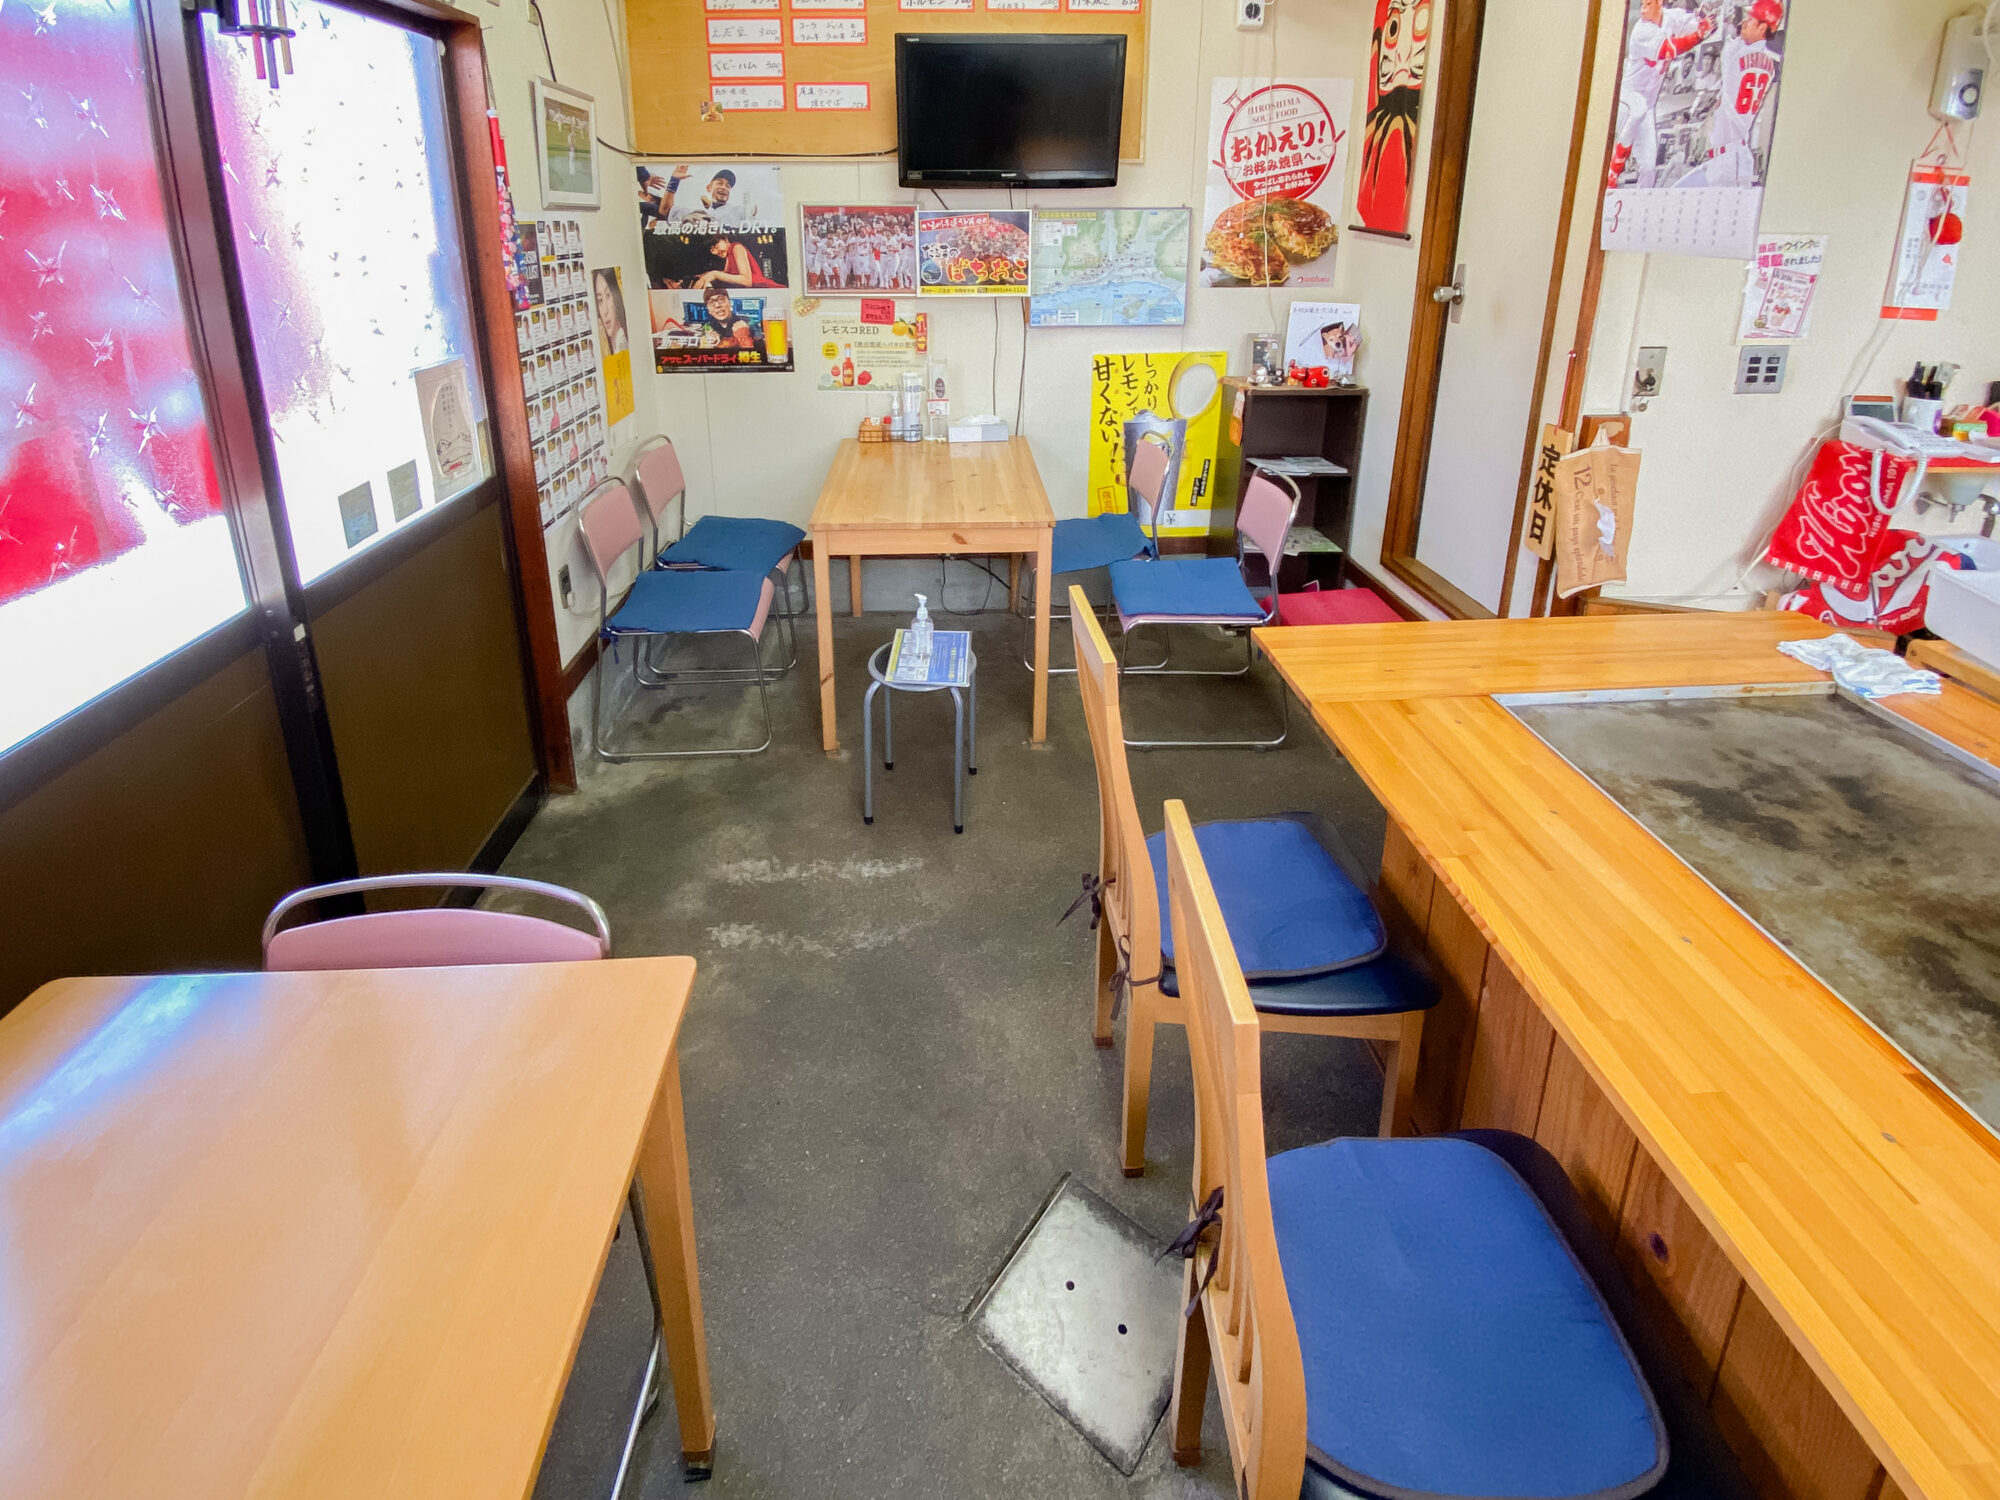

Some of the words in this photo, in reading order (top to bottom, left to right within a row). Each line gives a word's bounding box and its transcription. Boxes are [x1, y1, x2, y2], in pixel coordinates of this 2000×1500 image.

[1248, 97, 1301, 115] HIROSHIMA
[1276, 108, 1299, 120] FOOD
[821, 325, 880, 336] レモスコRED
[1144, 353, 1159, 411] しっかり
[1574, 466, 1591, 489] 12
[1530, 443, 1560, 545] 定休日
